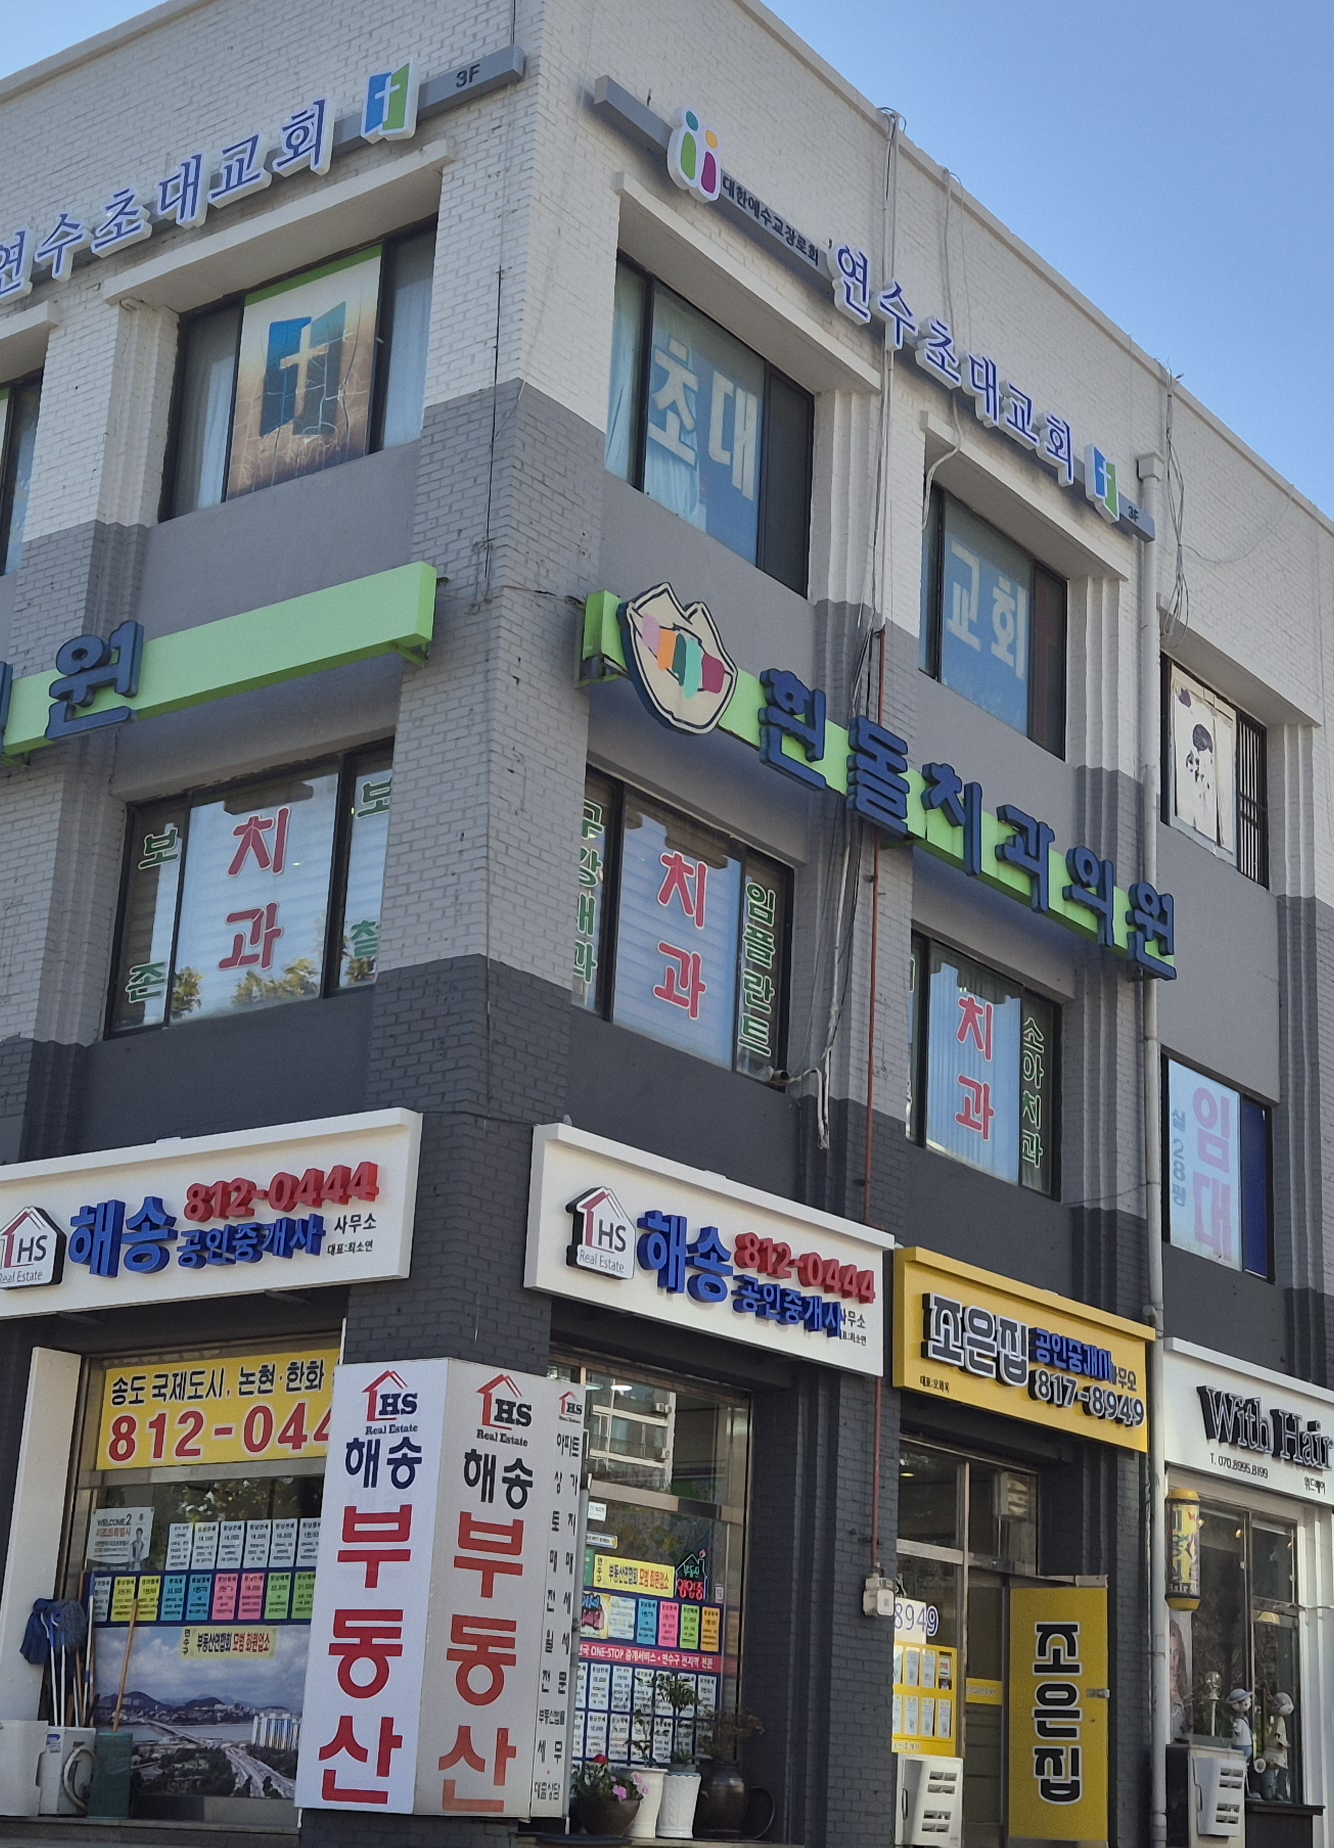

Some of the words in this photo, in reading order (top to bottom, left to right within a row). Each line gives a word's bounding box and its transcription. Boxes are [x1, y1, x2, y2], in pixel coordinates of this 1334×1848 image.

[455, 64, 481, 88] 3F
[835, 244, 1074, 486] 연수초대교회
[647, 332, 759, 502] 초대
[946, 539, 1027, 681] 교회
[759, 667, 1177, 980] 흰돌치과의원
[216, 806, 292, 971] 치과
[652, 850, 708, 1020] 치과
[737, 881, 776, 1057] 임플란트
[955, 995, 995, 1141] 치과
[183, 1160, 380, 1222] 812-0444
[1192, 1086, 1232, 1262] 임대
[16, 1233, 49, 1267] HS
[68, 1196, 178, 1278] 해송
[177, 1213, 327, 1269] 공인중개사
[333, 1213, 378, 1236] 사무소
[597, 1221, 627, 1252] HS
[637, 1209, 734, 1303] 해송
[734, 1231, 876, 1305] 812-0444
[732, 1273, 844, 1338] 공인중개사
[921, 1292, 1029, 1387] 조은집
[110, 1374, 147, 1406] 송도
[378, 1392, 418, 1416] HS
[493, 1397, 533, 1428] HS
[1027, 1368, 1146, 1428] 817-8949
[1196, 1385, 1274, 1455] With
[344, 1436, 423, 1490] 해송
[364, 1424, 388, 1436] Real
[389, 1422, 419, 1435] Estate
[475, 1429, 497, 1443] Real
[498, 1431, 529, 1447] Estate
[556, 1432, 580, 1458] 아파트
[463, 1448, 535, 1510] 해송
[317, 1503, 414, 1805] 부동산
[437, 1510, 525, 1814] 부동산
[590, 1644, 625, 1659] ONE-STOP
[1032, 1620, 1084, 1806] 조은집
